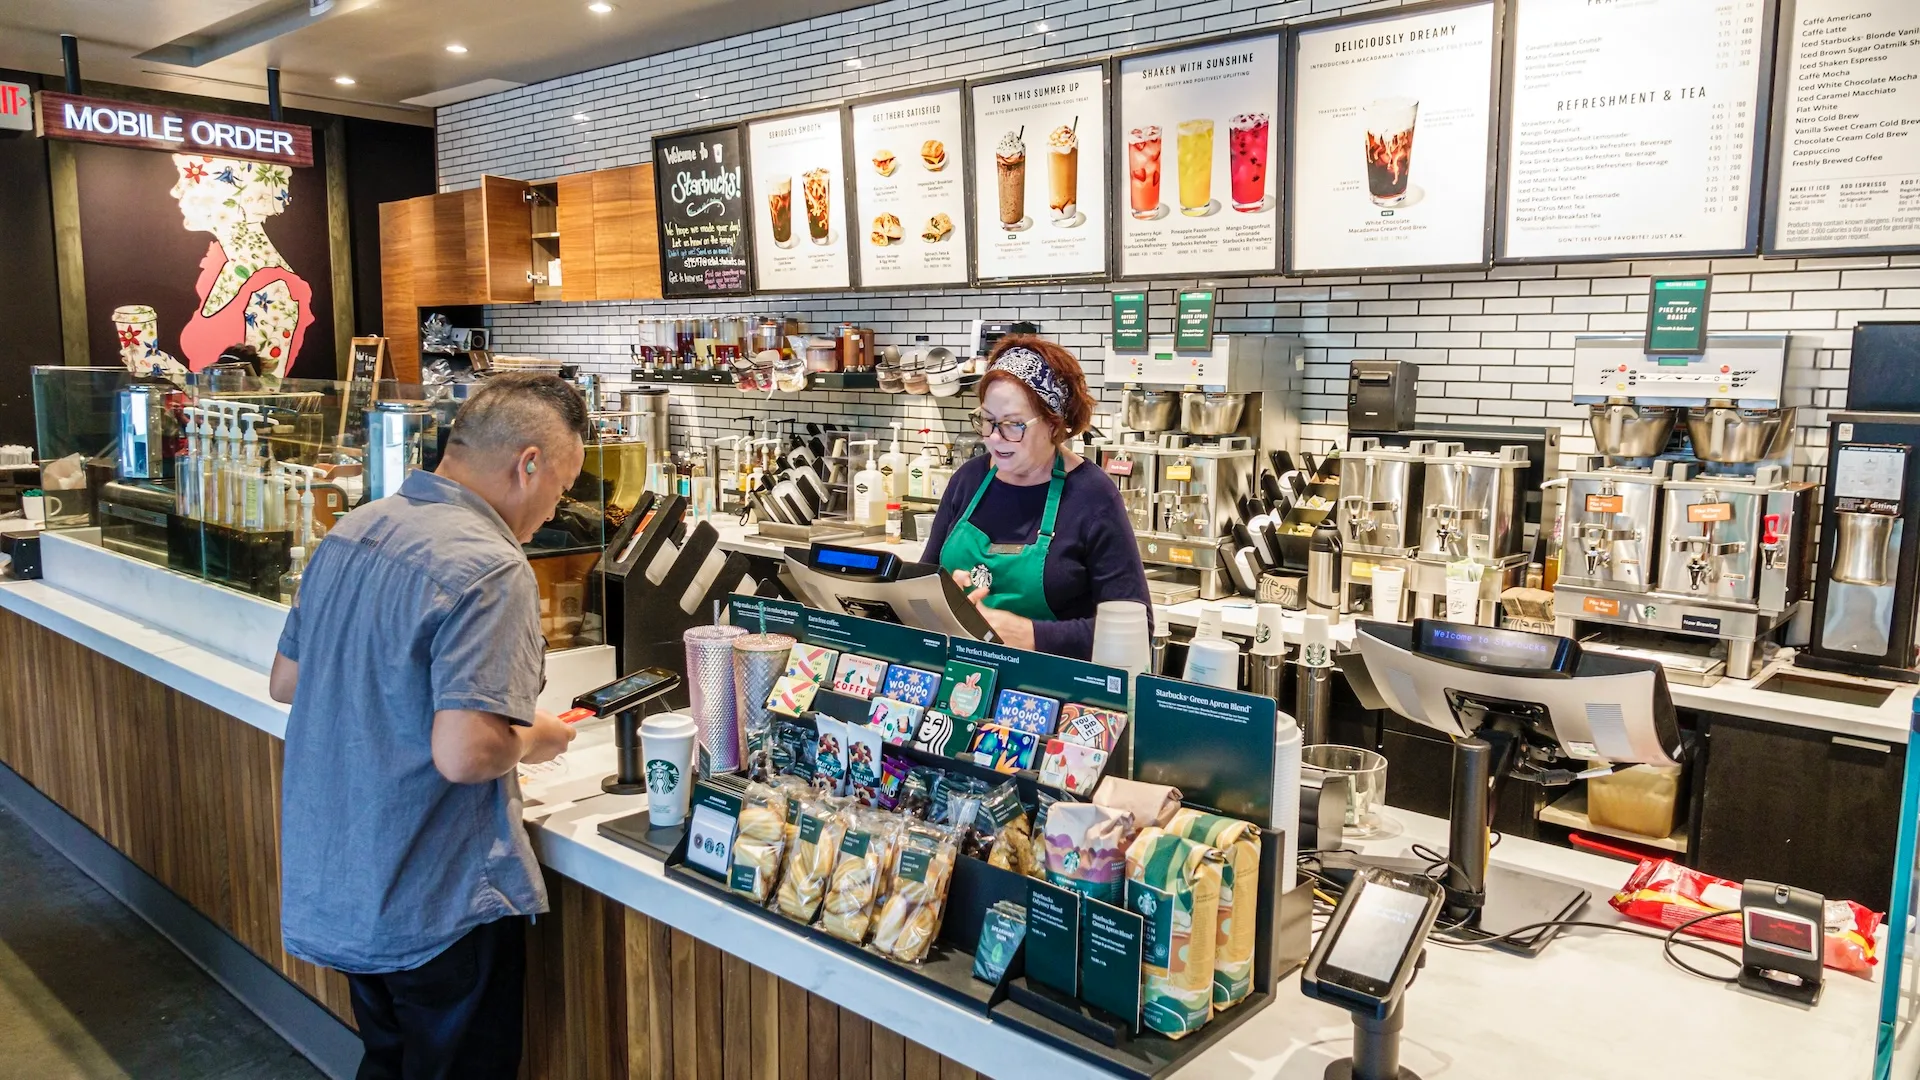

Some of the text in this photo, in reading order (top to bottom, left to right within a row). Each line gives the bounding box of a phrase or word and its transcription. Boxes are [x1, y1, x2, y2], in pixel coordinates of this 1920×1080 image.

[1803, 12, 1872, 26] Caffè Americano
[1802, 26, 1847, 37] Caffè Latte
[1334, 25, 1457, 53] DELICIOUSLY DREAMY
[1801, 40, 1819, 48] Iced
[1866, 31, 1896, 40] Blonde
[1800, 40, 1908, 59] Iced Brown Sugar Oatmilk
[1142, 52, 1254, 80] SHAKEN WITH SUNSHINE
[1310, 59, 1350, 69] INTRODUCING
[1356, 53, 1394, 63] MACADAMIA
[1800, 55, 1888, 70] Iced Shaken Espresso
[1194, 75, 1222, 83] POSITIVELY
[1223, 70, 1250, 79] UPLIFTING
[1799, 70, 1851, 81] Caffè Mocha
[1798, 74, 1918, 92] Iced White Chocolate Mocha
[0, 84, 19, 116] IT
[992, 82, 1080, 104] TURN THIS SUMMER UP
[1557, 86, 1707, 112] REFRESHMENT & TEA
[1816, 91, 1851, 101] Caramel
[1852, 87, 1897, 97] Macchiato
[873, 104, 941, 123] GET THERE SATISFIED
[1796, 105, 1811, 113] Flat
[1795, 116, 1816, 124] Nitro
[1818, 114, 1837, 122] Cold
[64, 103, 295, 156] MOBILE ORDER
[769, 123, 821, 140] SERIOUSLY SMOOTH
[1795, 127, 1821, 135] Vanilla
[1823, 125, 1848, 133] Sweet
[1850, 122, 1878, 130] Cream
[1879, 119, 1899, 127] Cold
[1793, 137, 1834, 146] Chocolate
[1836, 134, 1863, 142] Cream
[1865, 132, 1884, 140] Cold
[664, 142, 709, 165] Welcome to
[1793, 147, 1841, 157] Cappuccino
[1792, 154, 1883, 167] Freshly Brewed Coffee
[671, 165, 742, 204] Starbucks!
[1855, 181, 1887, 189] ESPRESSO
[1584, 191, 1621, 200] Lemonade
[1533, 214, 1556, 222] English
[665, 218, 741, 237] We hope we made your day!
[1348, 226, 1380, 234] Macadamia
[1666, 313, 1688, 321] ROAST
[1870, 502, 1899, 514] ditting
[1696, 621, 1718, 630] Brewing
[1434, 629, 1547, 652] Welcome to Starbucks
[965, 647, 982, 657] Perfect
[982, 650, 1007, 661] Starbucks
[1007, 656, 1020, 664] Card
[834, 681, 873, 697] COFFEE
[889, 680, 928, 697] WOOHOO
[1155, 688, 1187, 701] Starbucks
[1189, 695, 1209, 705] Green
[1209, 699, 1229, 709] Apron
[1001, 705, 1046, 725] WOOHOO
[1074, 717, 1089, 726] YOU
[1083, 720, 1097, 730] DID
[1085, 728, 1095, 737] IT!
[1032, 891, 1054, 904] Starbucks
[1032, 897, 1063, 914] Odyssey Blend
[991, 925, 1015, 939] SPEARMINT
[1091, 920, 1106, 930] Green
[1106, 924, 1120, 934] Apron
[995, 933, 1007, 942] GUM
